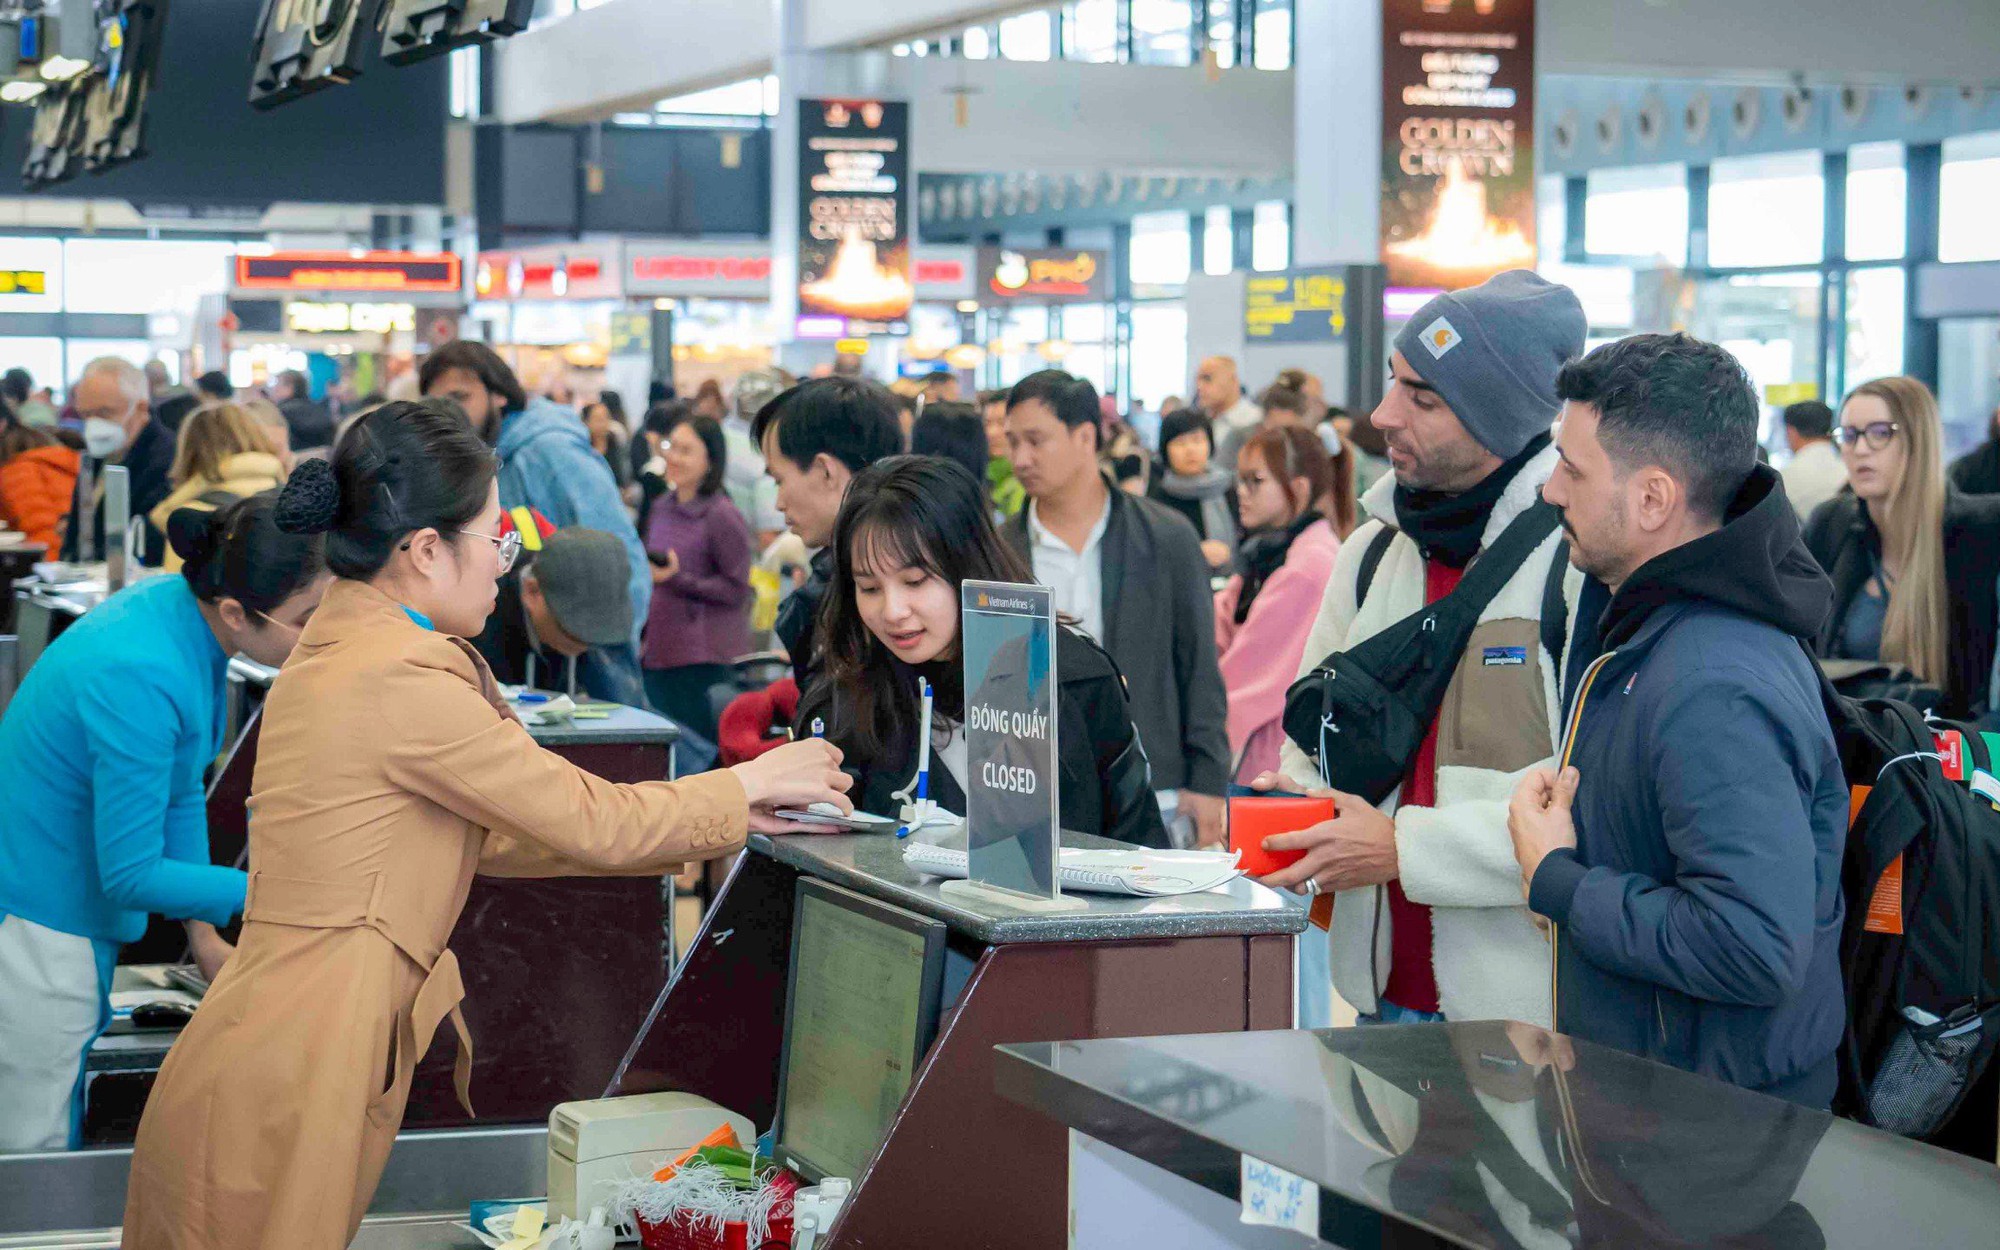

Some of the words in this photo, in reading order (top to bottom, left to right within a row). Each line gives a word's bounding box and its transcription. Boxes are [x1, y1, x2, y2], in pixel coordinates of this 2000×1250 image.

[1485, 657, 1522, 665] patagonia
[971, 703, 1008, 734] ĐÓNG
[983, 761, 1036, 794] CLOSED
